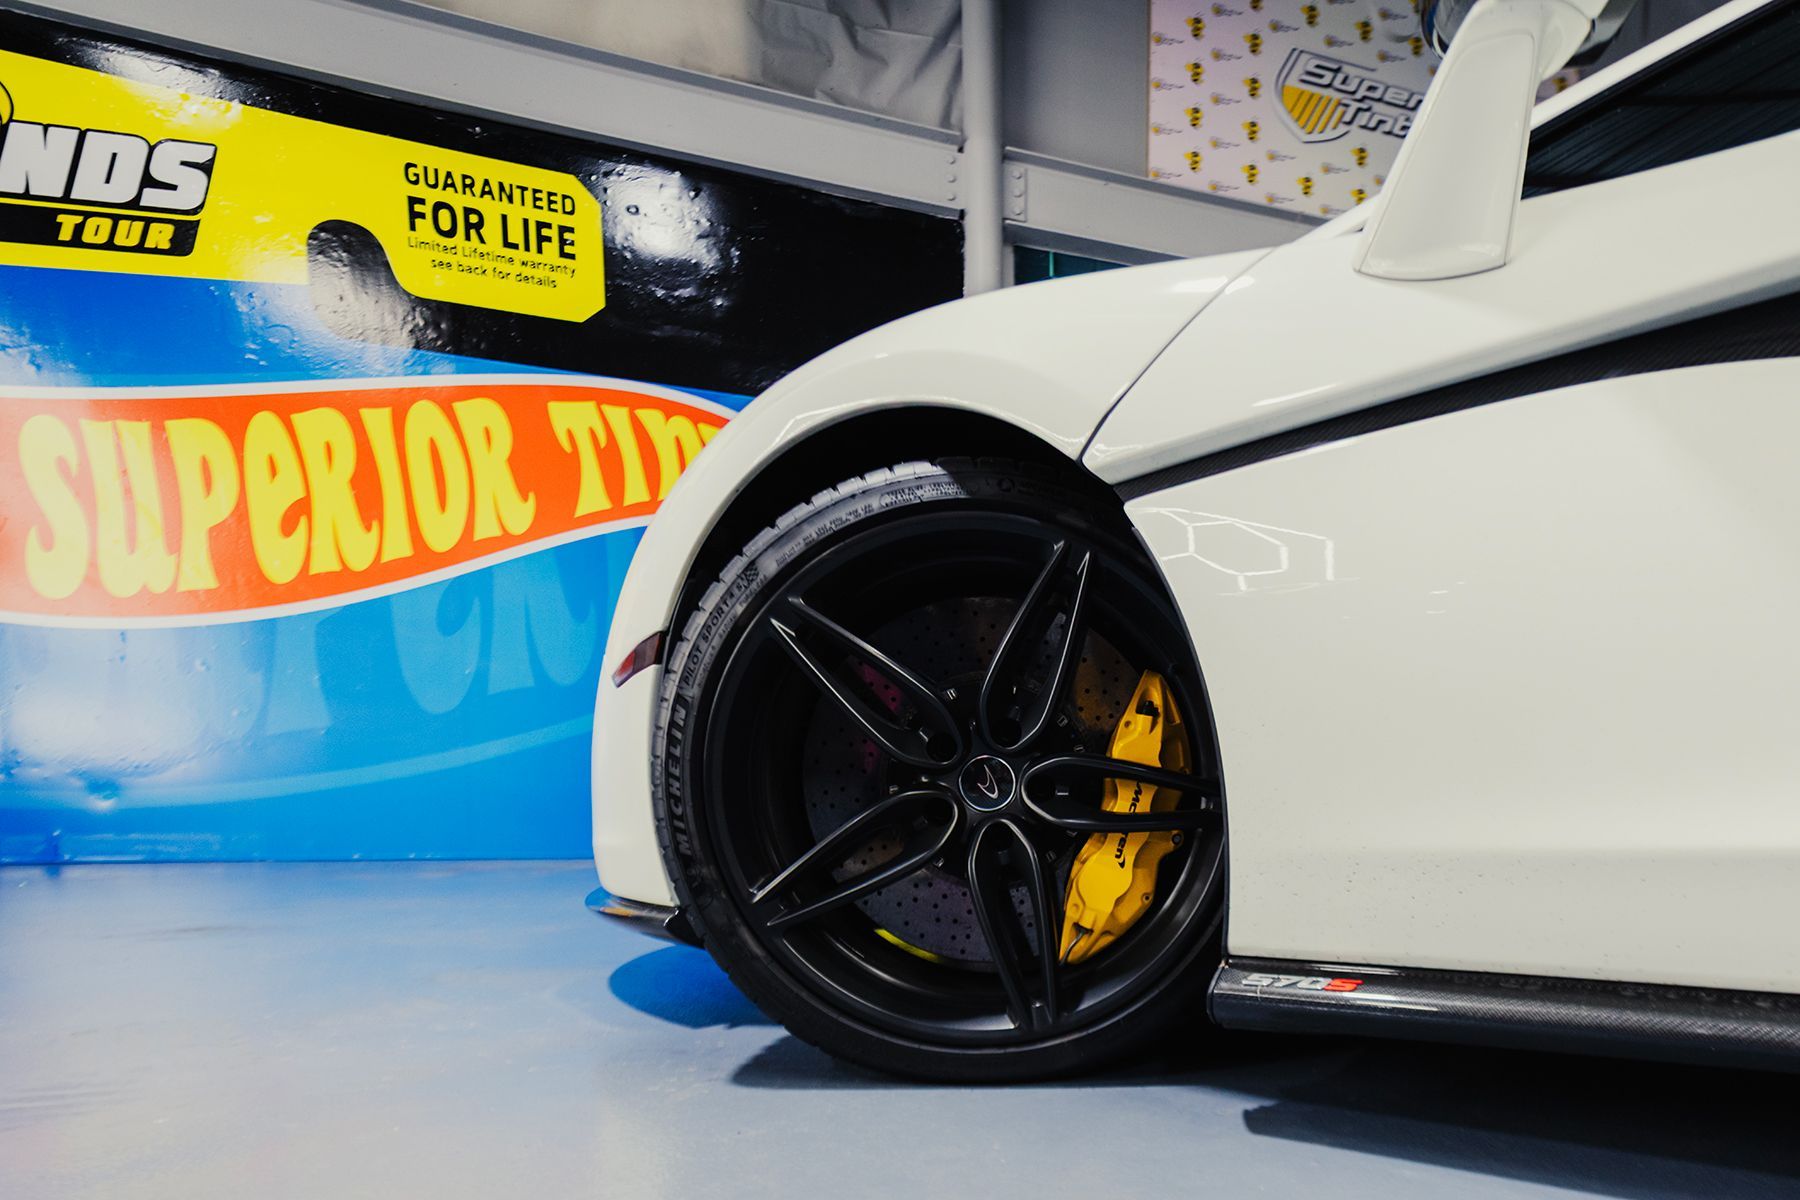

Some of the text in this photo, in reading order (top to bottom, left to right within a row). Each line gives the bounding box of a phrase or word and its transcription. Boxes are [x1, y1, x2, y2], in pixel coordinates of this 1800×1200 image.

[404, 162, 576, 216] GUARANTEED
[56, 214, 175, 250] TOUR
[407, 195, 577, 260] FOR LIFE
[407, 236, 576, 278] Limited Lifetime warranty
[431, 258, 557, 289] see back for details
[684, 647, 704, 687] PILOT
[701, 600, 730, 643] SPORT
[668, 703, 693, 857] MICHELIN
[1242, 972, 1364, 993] 570S
